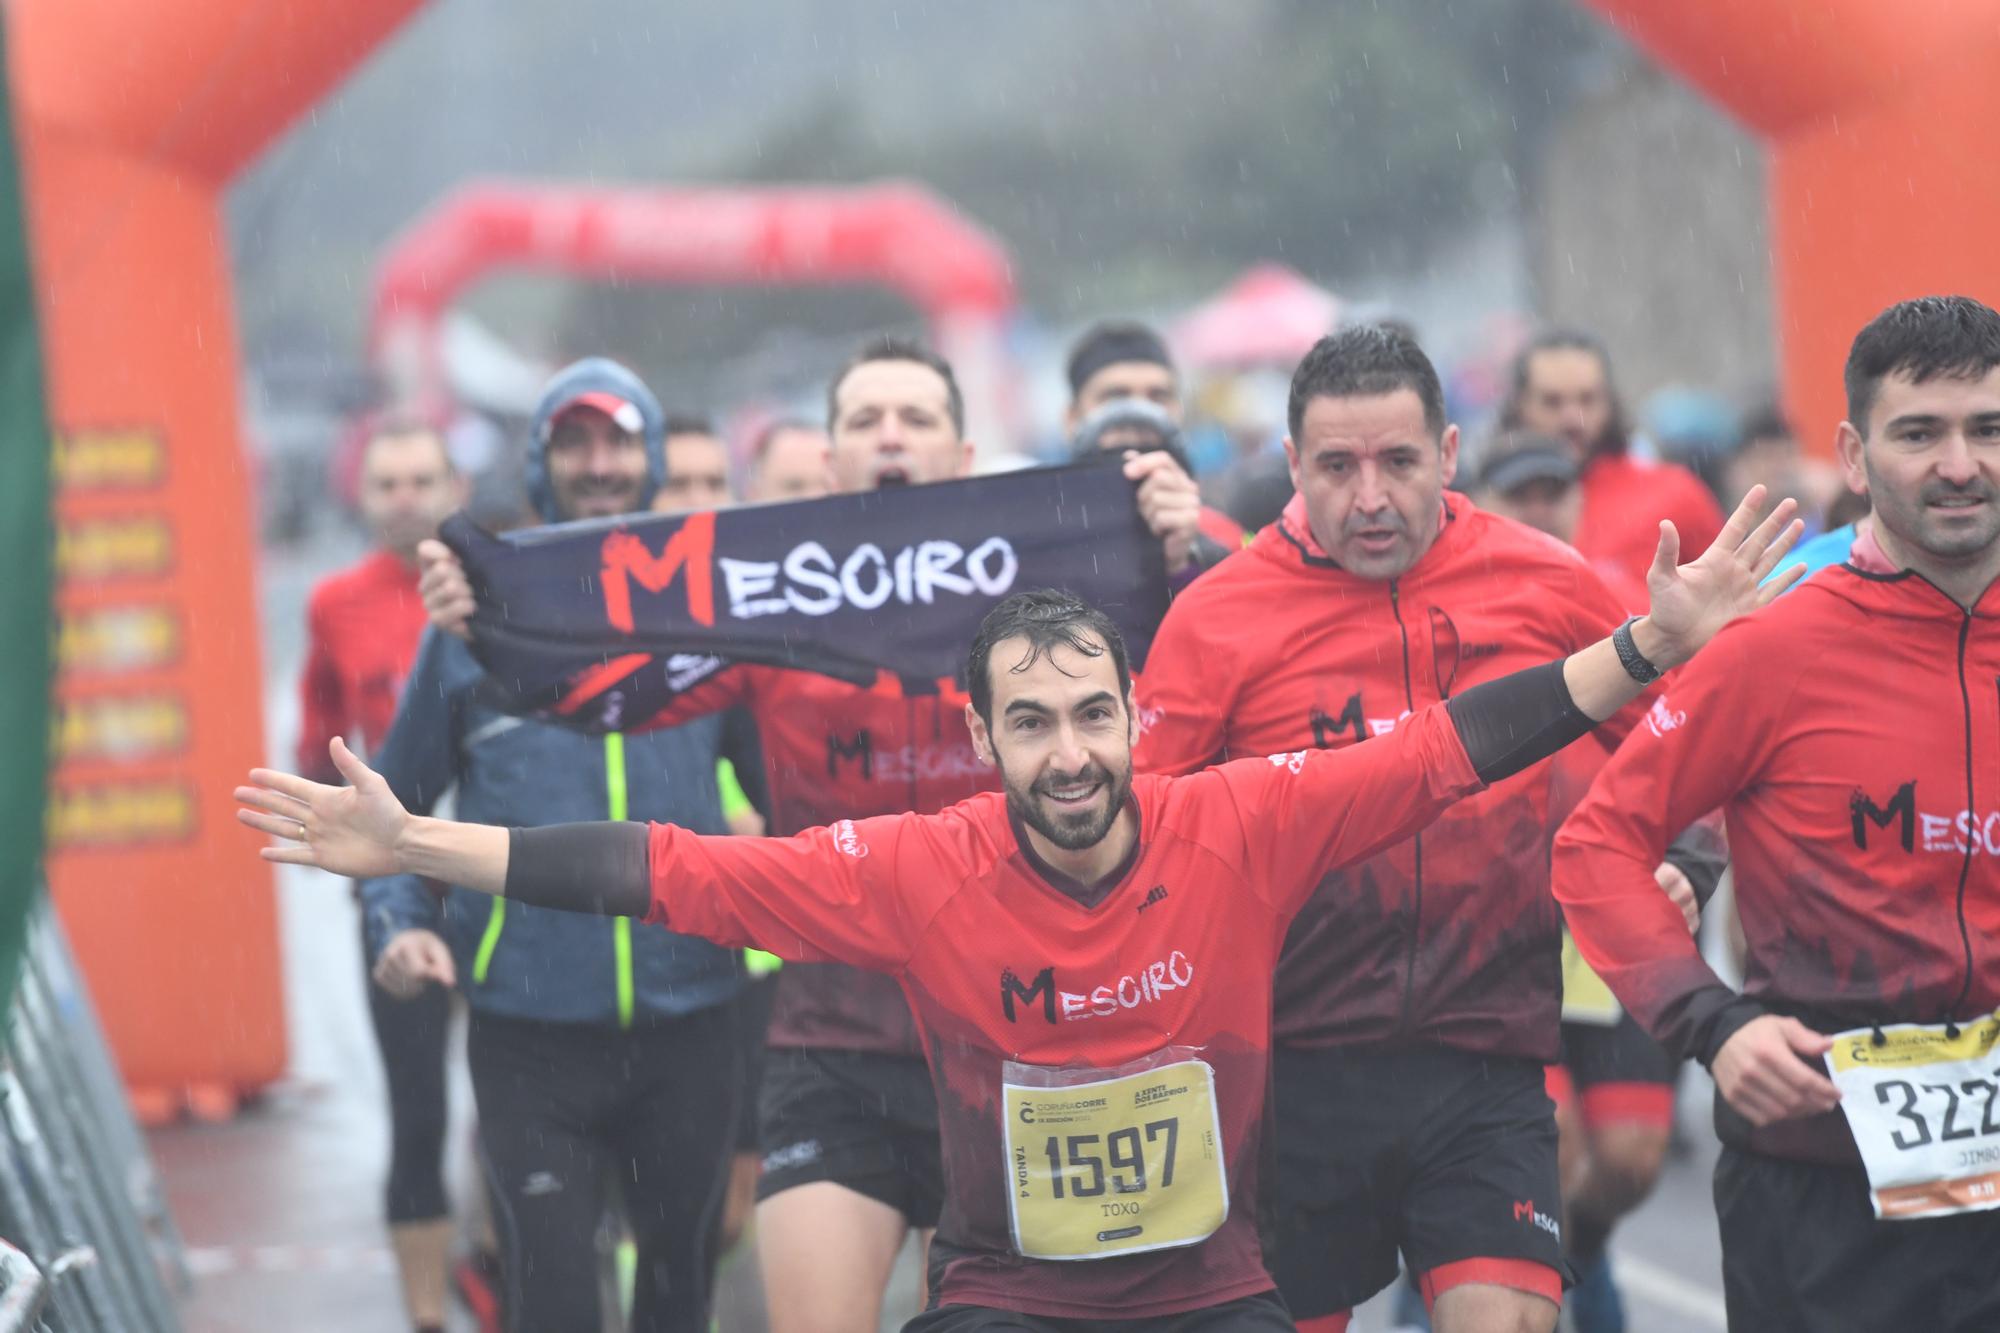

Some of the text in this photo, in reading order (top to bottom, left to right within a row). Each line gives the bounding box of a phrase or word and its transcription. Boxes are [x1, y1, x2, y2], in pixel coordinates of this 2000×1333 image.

[1874, 1067, 2000, 1151] 322
[1016, 1146, 1030, 1199] TANDA 4
[1045, 1117, 1178, 1199] 1597
[1101, 1202, 1140, 1217] TOXO
